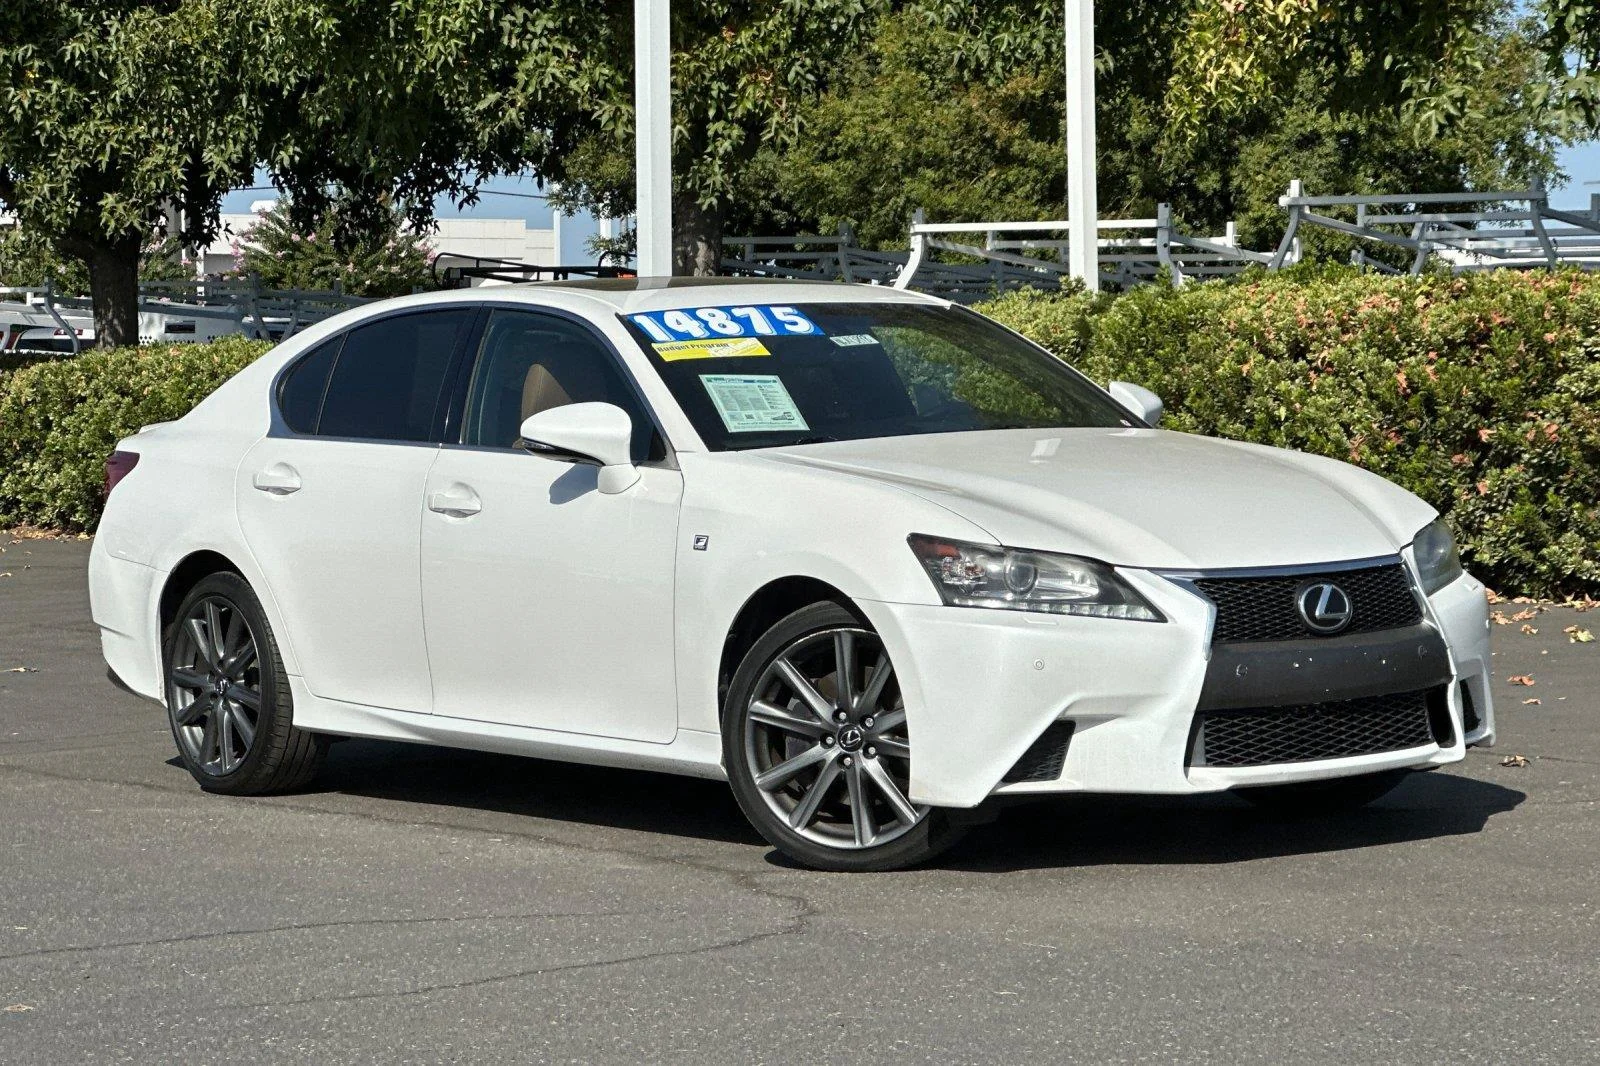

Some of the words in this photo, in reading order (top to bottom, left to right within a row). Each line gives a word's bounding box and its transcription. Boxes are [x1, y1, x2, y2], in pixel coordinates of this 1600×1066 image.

[633, 306, 815, 341] 14875
[656, 344, 690, 353] Budget
[690, 342, 730, 351] Program
